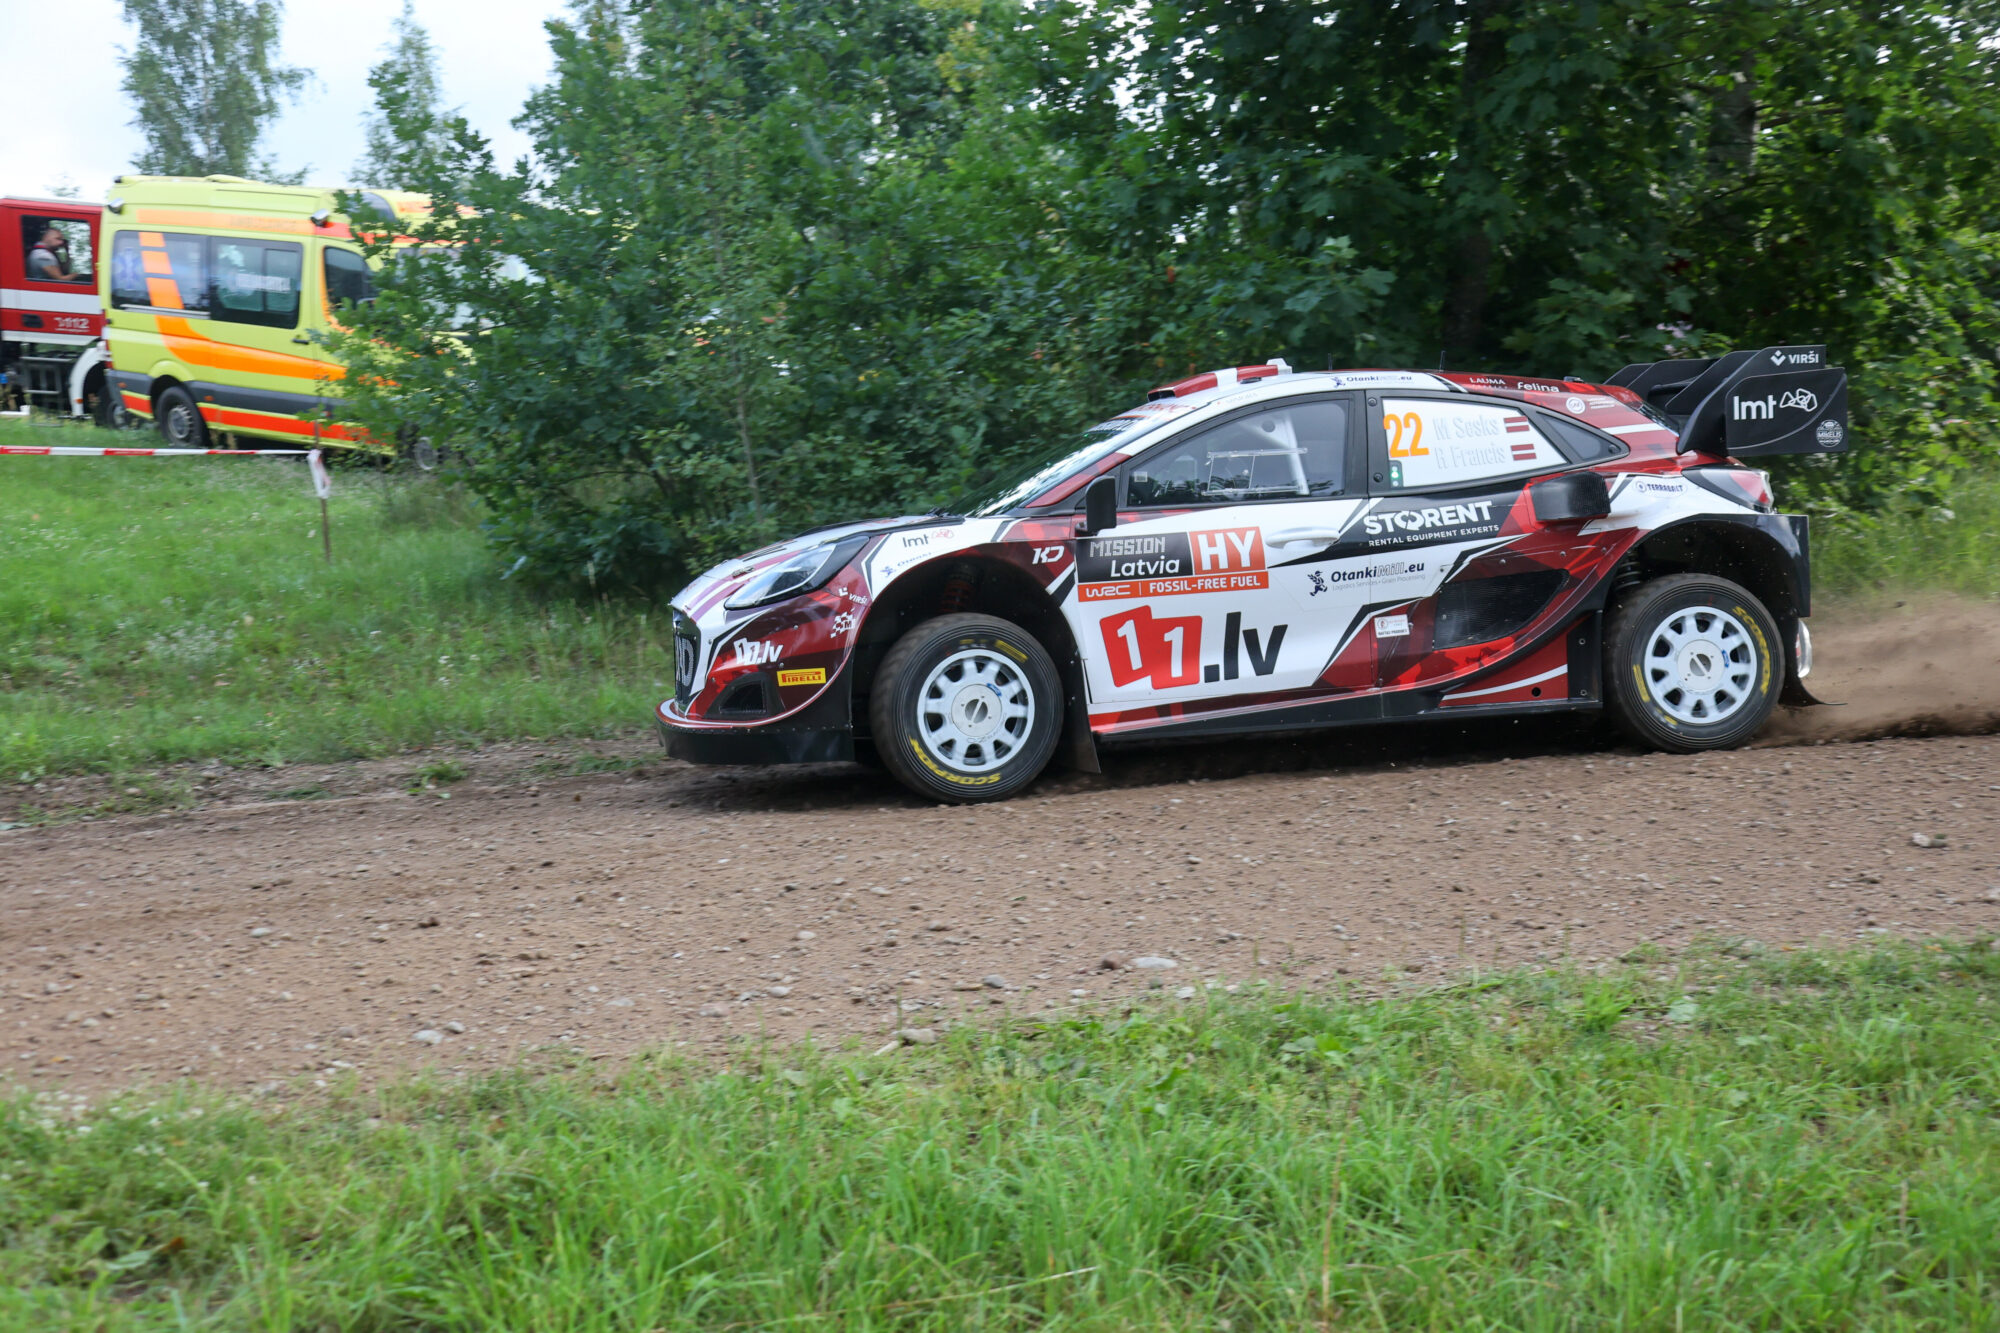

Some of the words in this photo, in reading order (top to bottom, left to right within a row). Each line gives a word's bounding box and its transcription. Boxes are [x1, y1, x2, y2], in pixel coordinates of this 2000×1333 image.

[1788, 350, 1819, 364] VIRŠI
[1469, 377, 1506, 385] LAUMA
[1733, 394, 1777, 420] lmt
[1383, 412, 1430, 458] 22
[1432, 417, 1451, 440] M
[1453, 414, 1499, 438] Sesks
[1435, 446, 1448, 469] R
[1453, 443, 1506, 467] Francis
[1363, 500, 1493, 535] STORENT
[902, 533, 929, 548] lmt
[1089, 536, 1166, 557] MISSION
[1368, 535, 1405, 547] RENTAL
[1406, 529, 1458, 542] EQUIPMENT
[1460, 524, 1500, 536] EXPERTS
[1197, 530, 1256, 571] HY
[1110, 555, 1180, 578] Latvia
[1331, 562, 1425, 582] OtankiMill.eu
[1085, 584, 1132, 598] WRC
[1149, 577, 1228, 594] FOSSIL-FREE
[1230, 575, 1261, 588] FUEL
[1112, 608, 1288, 685] 11.lv
[781, 671, 821, 683] PIRELLI
